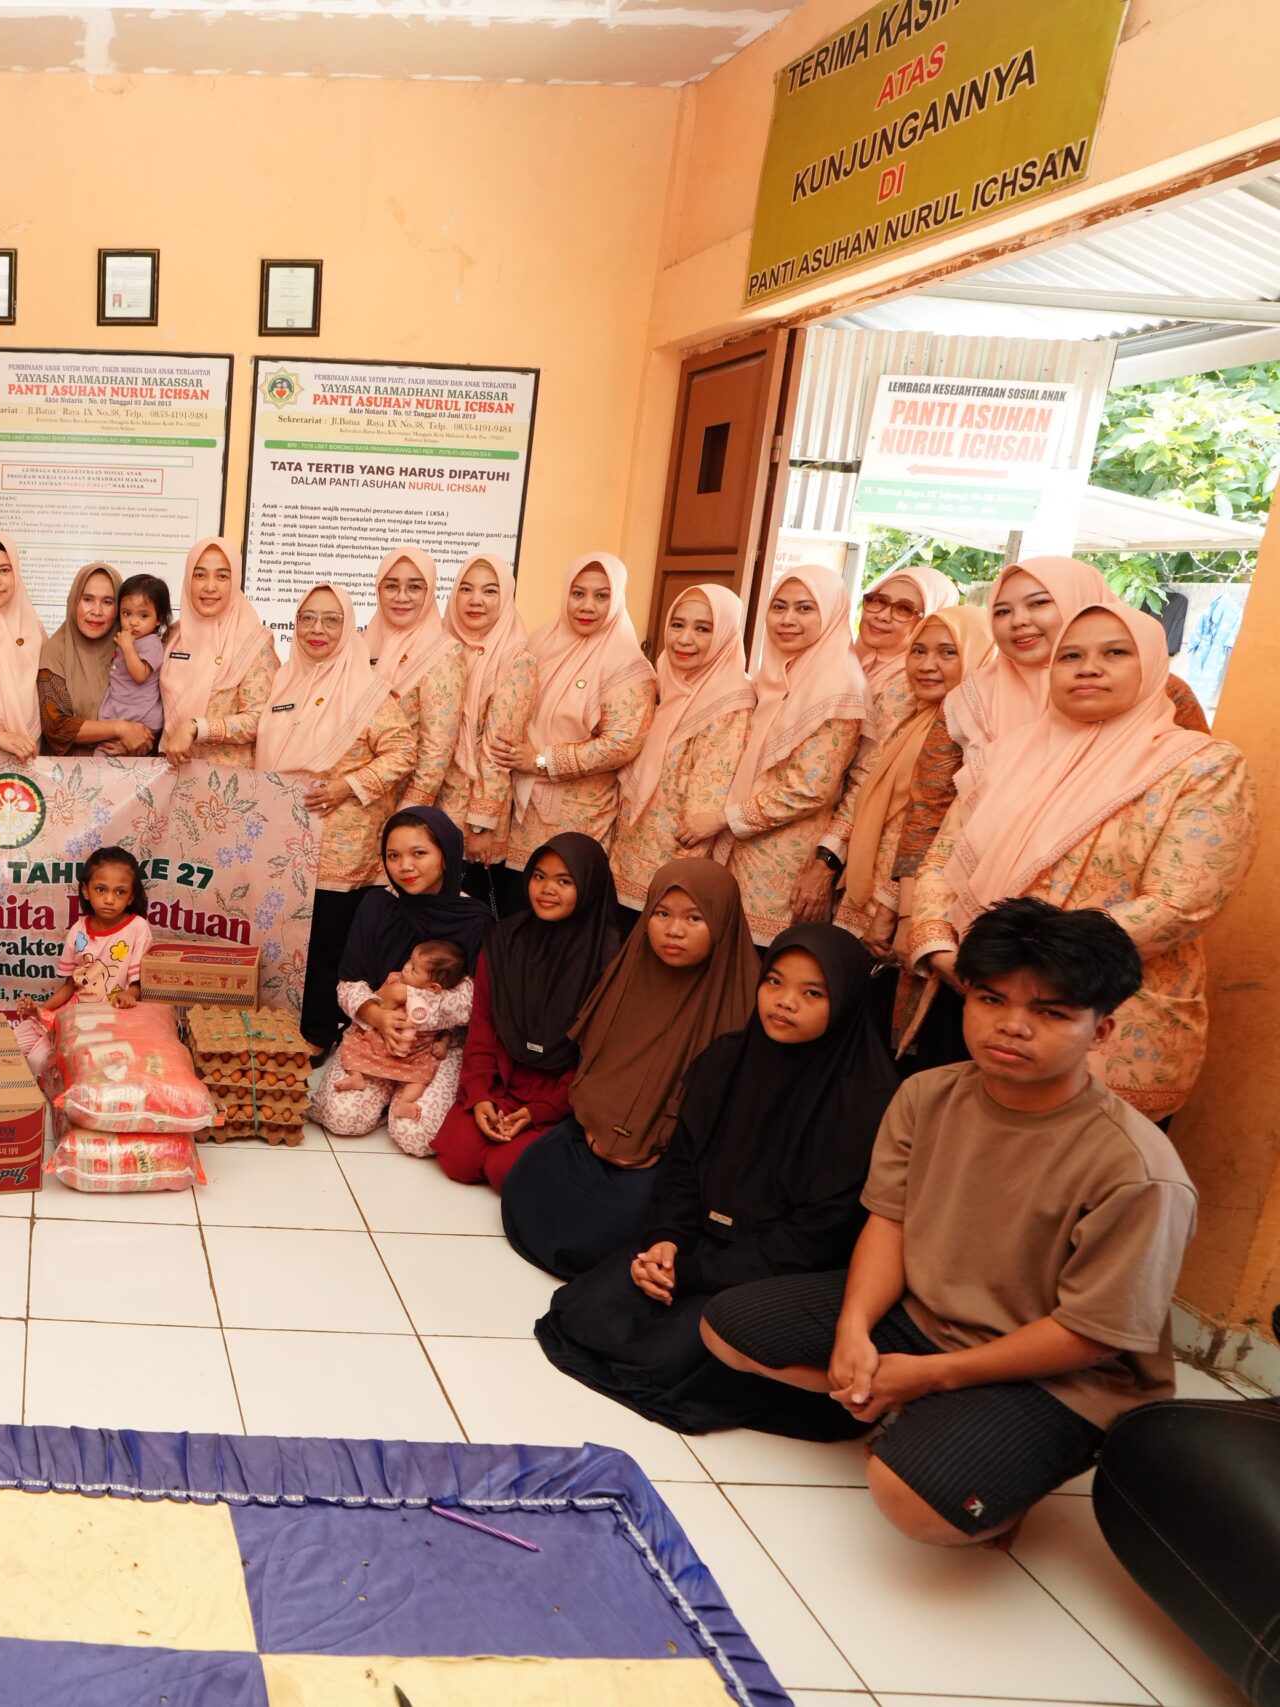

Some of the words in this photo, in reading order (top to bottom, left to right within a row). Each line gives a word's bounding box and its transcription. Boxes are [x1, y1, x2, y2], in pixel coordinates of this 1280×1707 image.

[787, 30, 869, 94] TERIMA
[875, 0, 960, 53] KASI
[875, 44, 947, 109] ATAS
[792, 49, 1037, 203] KUNJUNGANNYA
[878, 165, 906, 203] DI
[748, 258, 795, 298] PANTI
[797, 224, 879, 280] ASUHAN
[883, 193, 964, 247] NURUL
[971, 139, 1088, 213] ICHSAN
[15, 373, 65, 385] YAYASAN
[68, 374, 138, 386] RAMADHANI
[141, 376, 203, 388] MAKASSAR
[7, 383, 47, 396] PANTI
[50, 384, 107, 398] ASUHAN
[110, 386, 156, 399] NURUL
[159, 387, 210, 400] ICHSAN
[320, 383, 371, 395] YAYASAN
[373, 385, 444, 398] RAMADHANI
[446, 389, 508, 401] MAKASSAR
[887, 381, 931, 394] LEMBAGA
[931, 383, 1007, 398] KESEJAHTERAAN
[1006, 387, 1039, 400] SOSIAL
[1040, 389, 1066, 402] ANAK
[62, 407, 80, 416] Raya
[83, 408, 93, 416] IX
[312, 394, 352, 406] PANTI
[355, 395, 412, 410] ASUHAN
[415, 398, 461, 412] NURUL
[464, 400, 514, 414] ICHSAN
[277, 415, 322, 424] Sekretariat
[366, 418, 384, 427] Raya
[387, 419, 397, 428] IX
[889, 399, 958, 427] PANTI
[958, 403, 1054, 433] ASUHAN
[878, 428, 954, 457] NURUL
[958, 433, 1049, 463] ICHSAN
[270, 460, 303, 472] TATA
[306, 462, 354, 474] TERTIB
[358, 464, 395, 476] YANG
[398, 466, 444, 478] HARUS
[448, 468, 510, 481] DIPATUHI
[290, 475, 327, 486] DALAM
[328, 477, 359, 487] PANTI
[361, 478, 406, 489] ASUHAN
[408, 480, 443, 491] NURUL
[446, 482, 486, 493] ICHSAN
[177, 863, 214, 890] 27
[7, 1146, 19, 1155] Mi
